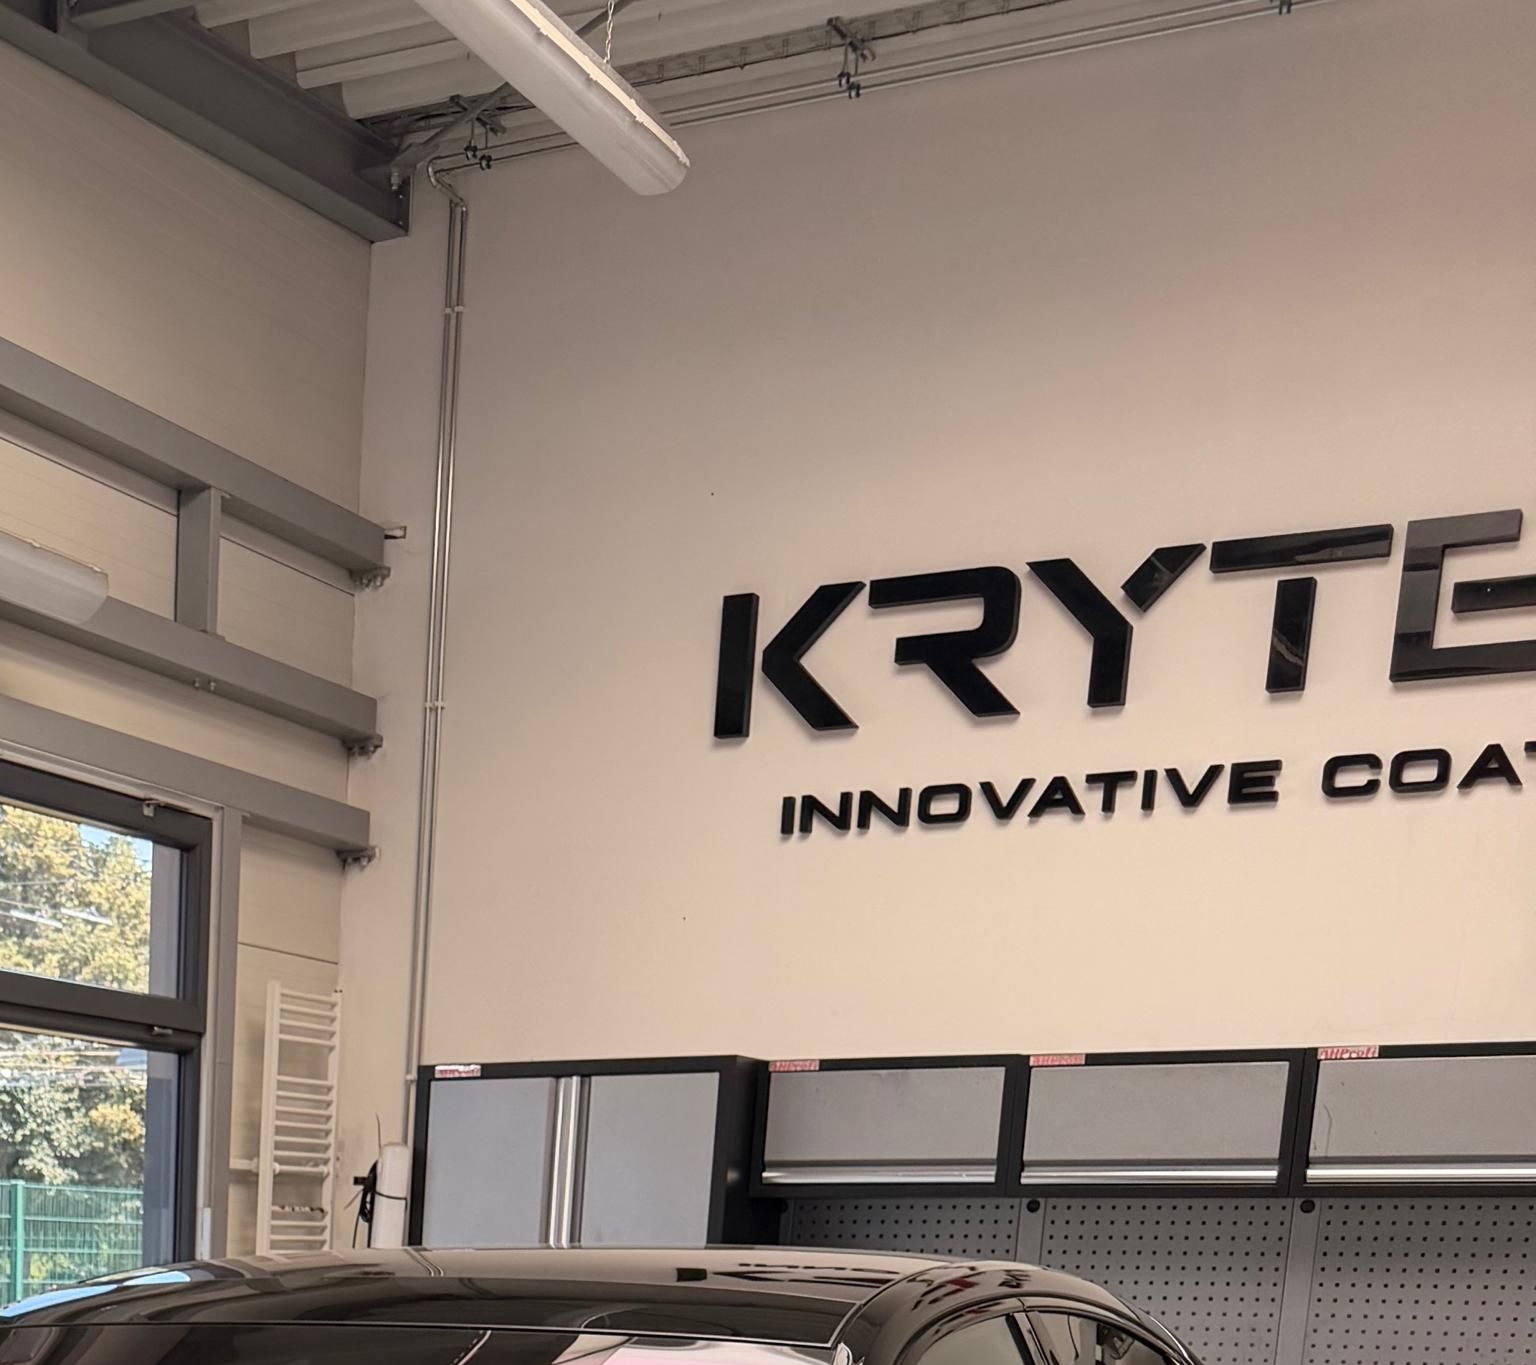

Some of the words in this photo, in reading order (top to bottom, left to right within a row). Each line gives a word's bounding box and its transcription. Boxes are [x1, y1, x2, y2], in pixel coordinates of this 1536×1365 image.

[714, 509, 1536, 739] KRYTE
[781, 760, 1283, 835] INNOVATIVE
[1321, 740, 1536, 799] COA
